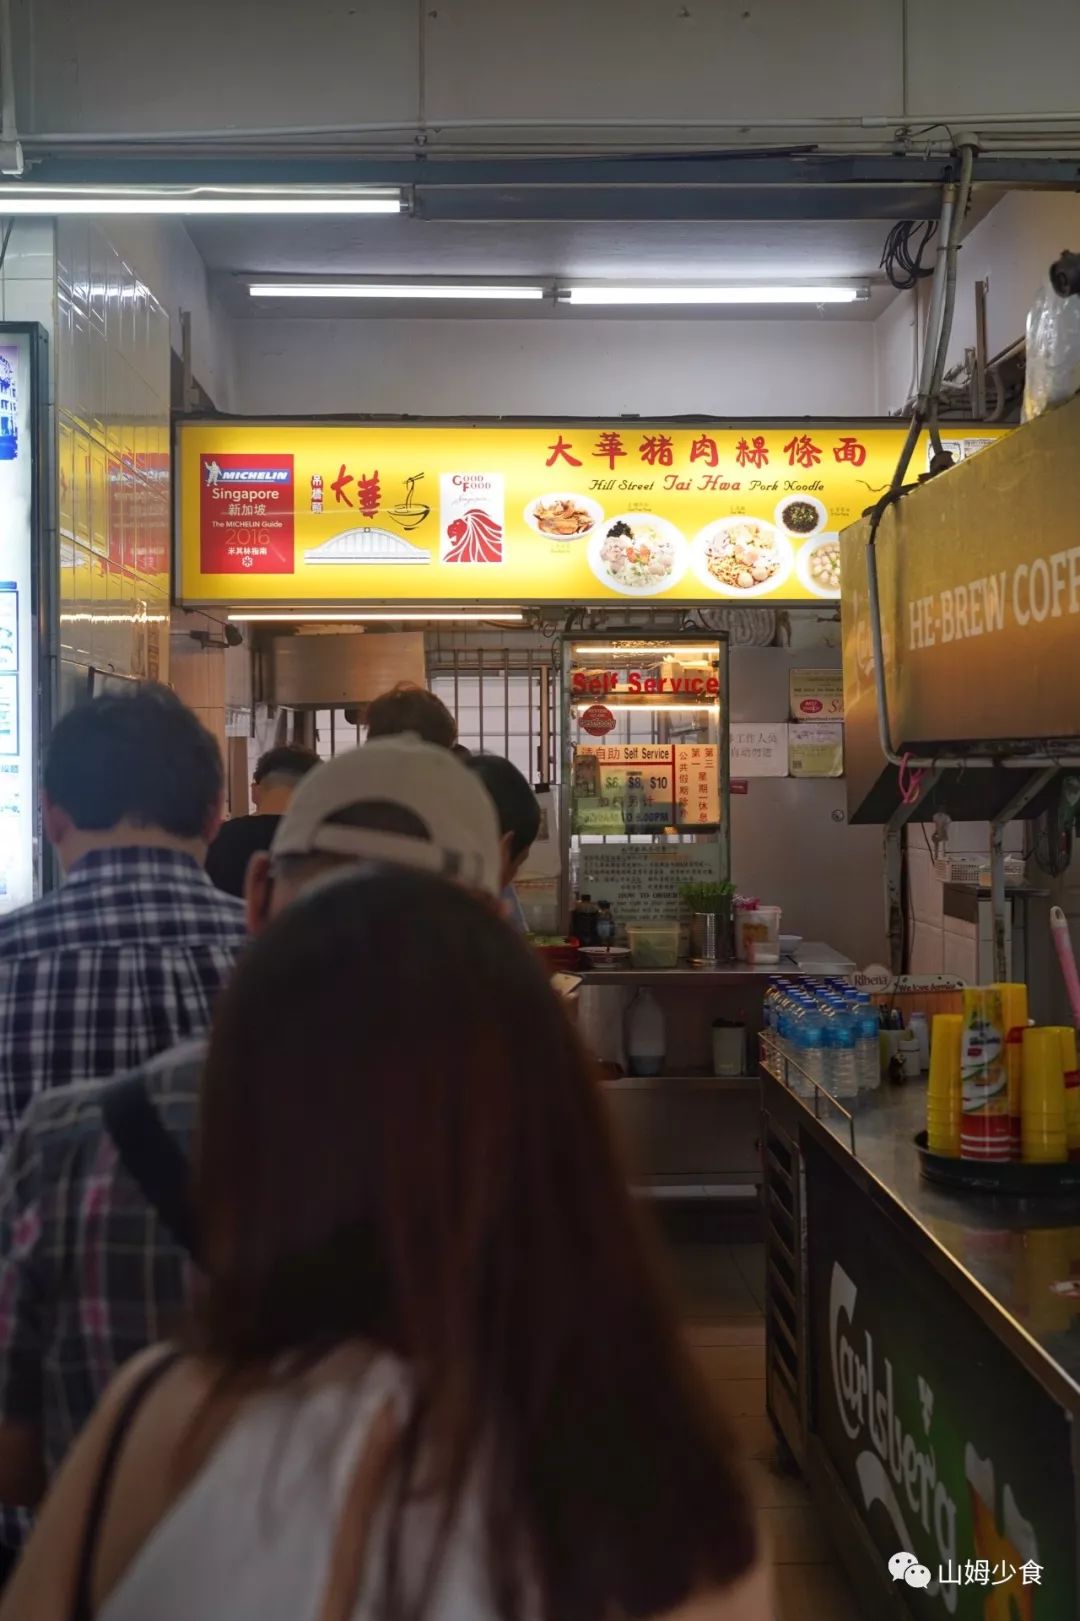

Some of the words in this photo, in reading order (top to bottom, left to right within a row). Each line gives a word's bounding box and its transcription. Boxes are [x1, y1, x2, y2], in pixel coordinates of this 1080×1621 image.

[222, 471, 289, 480] MICHELIN
[452, 475, 483, 486] GOOD
[463, 482, 491, 492] FOOD
[588, 480, 617, 491] Hill
[618, 480, 655, 491] Street
[663, 475, 693, 491] Tai
[697, 475, 742, 491] Hwa
[749, 480, 779, 491] Pork
[783, 480, 825, 491] Noodle
[212, 488, 280, 502] Singapore
[330, 463, 382, 519] 大華
[228, 504, 267, 516] 新加坡
[225, 529, 270, 545] 2016
[908, 572, 1007, 650] HE-BREW
[572, 673, 618, 695] Self
[628, 672, 719, 696] Service
[624, 748, 638, 759] Self
[641, 748, 670, 760] Service
[649, 776, 668, 790] $10
[854, 974, 888, 986] Ribena
